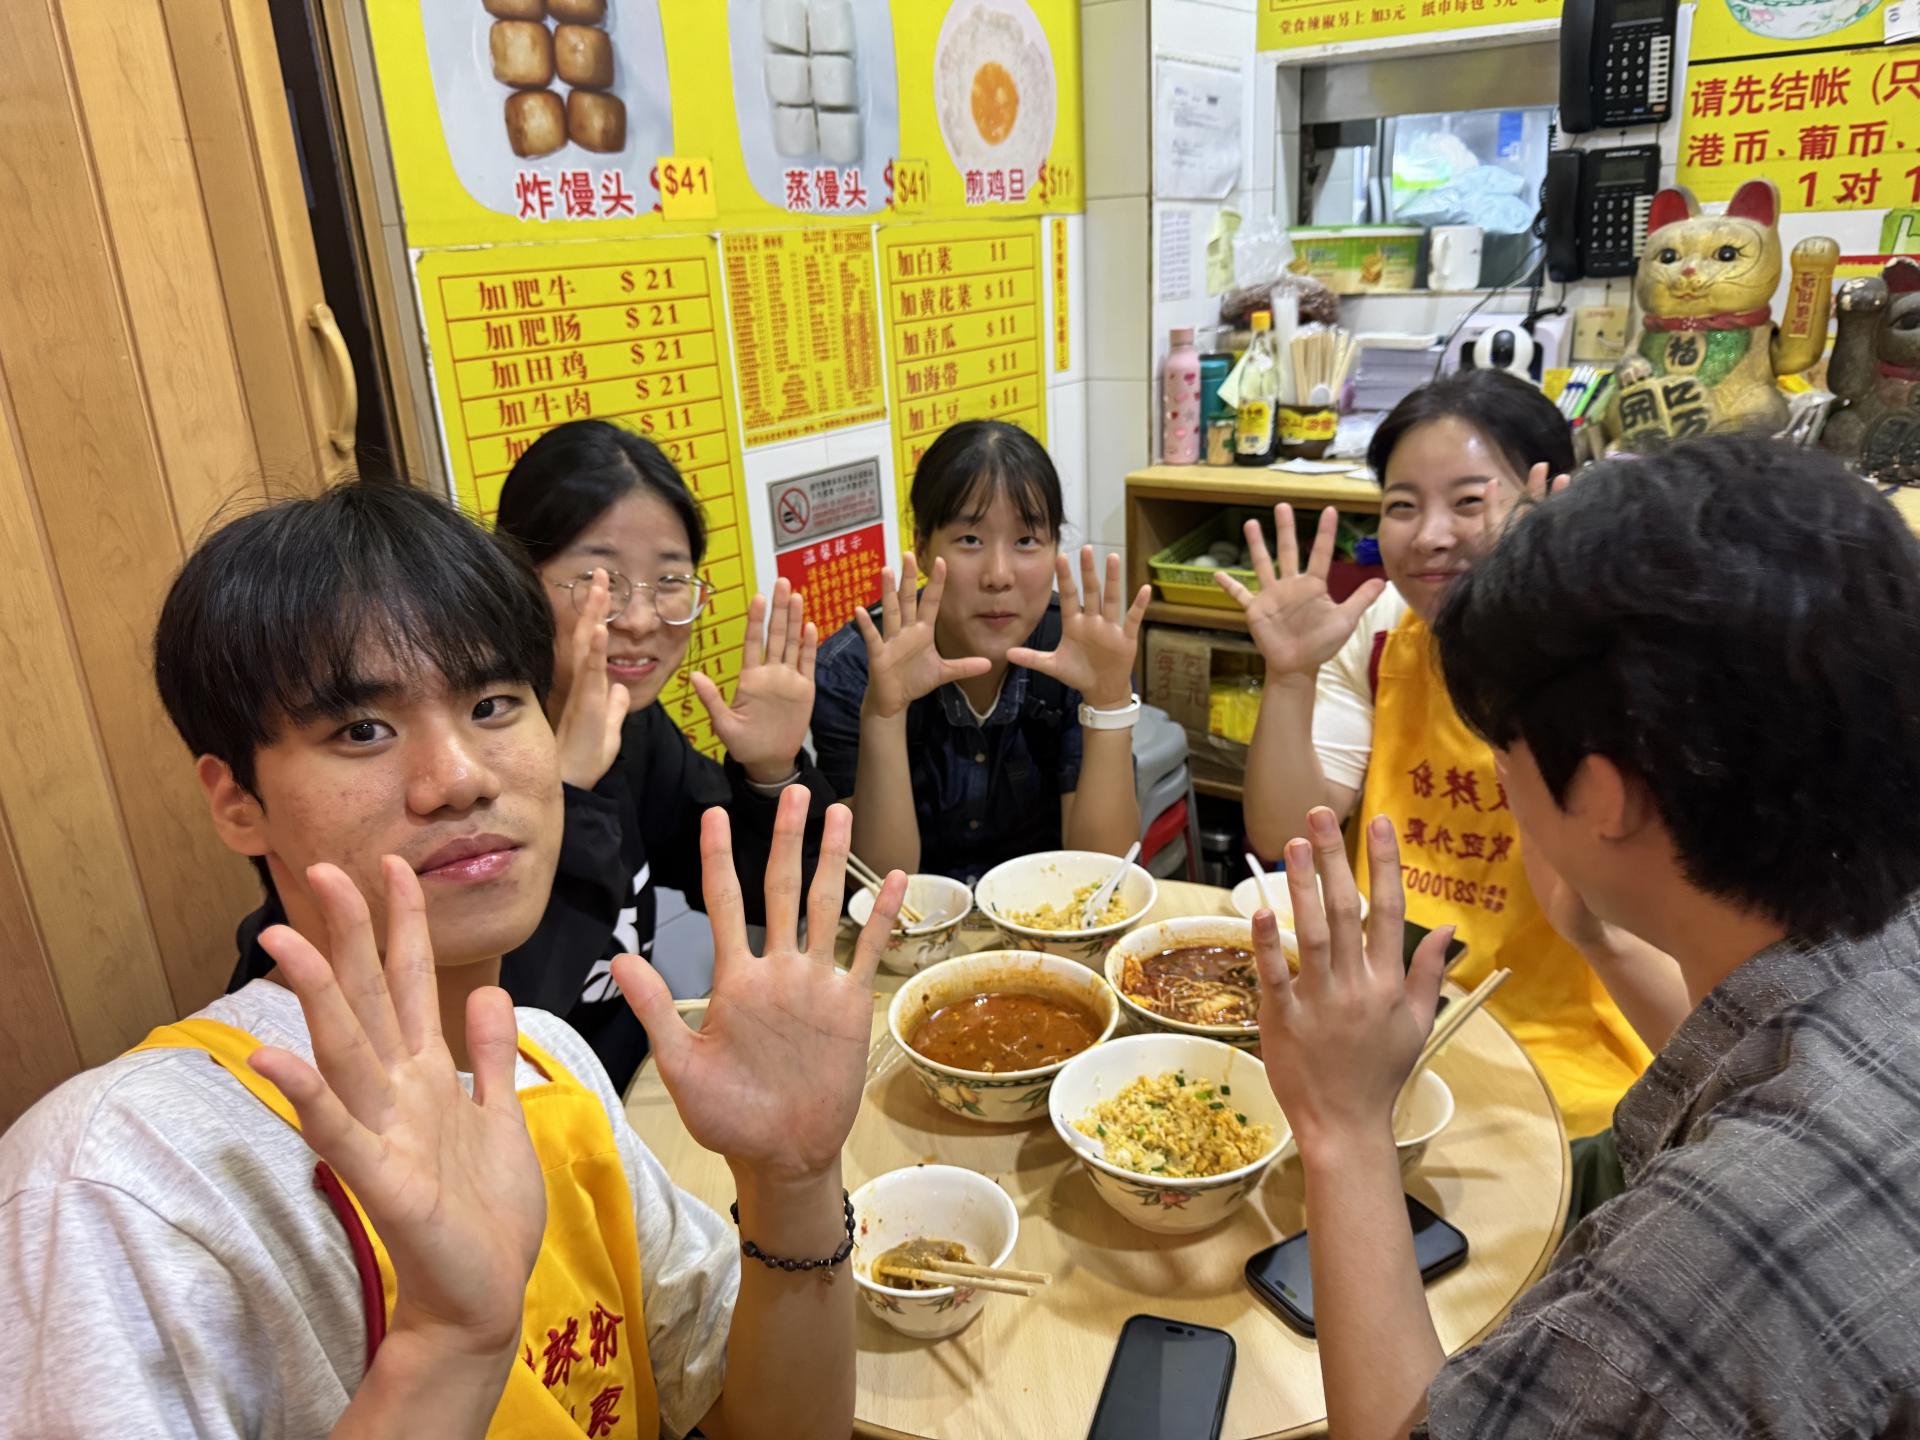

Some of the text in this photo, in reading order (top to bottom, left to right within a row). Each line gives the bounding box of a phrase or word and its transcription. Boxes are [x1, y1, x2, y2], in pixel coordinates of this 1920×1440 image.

[1687, 121, 1920, 168] 港币、葡币、
[516, 171, 634, 219] 炸馒头
[664, 164, 708, 196] $41
[785, 170, 866, 209] 蒸馒头
[899, 168, 927, 203] $41
[966, 168, 1025, 203] 煎鸡旦
[898, 242, 1006, 276] 加白菜 11
[479, 275, 576, 311] 加肥牛
[901, 283, 972, 317] 加黄花菜
[486, 313, 581, 351] 加肥肠
[904, 323, 956, 355] 加青瓜
[492, 351, 588, 389] 加田鸡
[906, 362, 957, 394] 加海带
[499, 388, 592, 427] 加牛肉
[909, 399, 959, 431] 加土豆
[802, 536, 862, 566] 温馨提示
[522, 1301, 623, 1388] 辣粉
